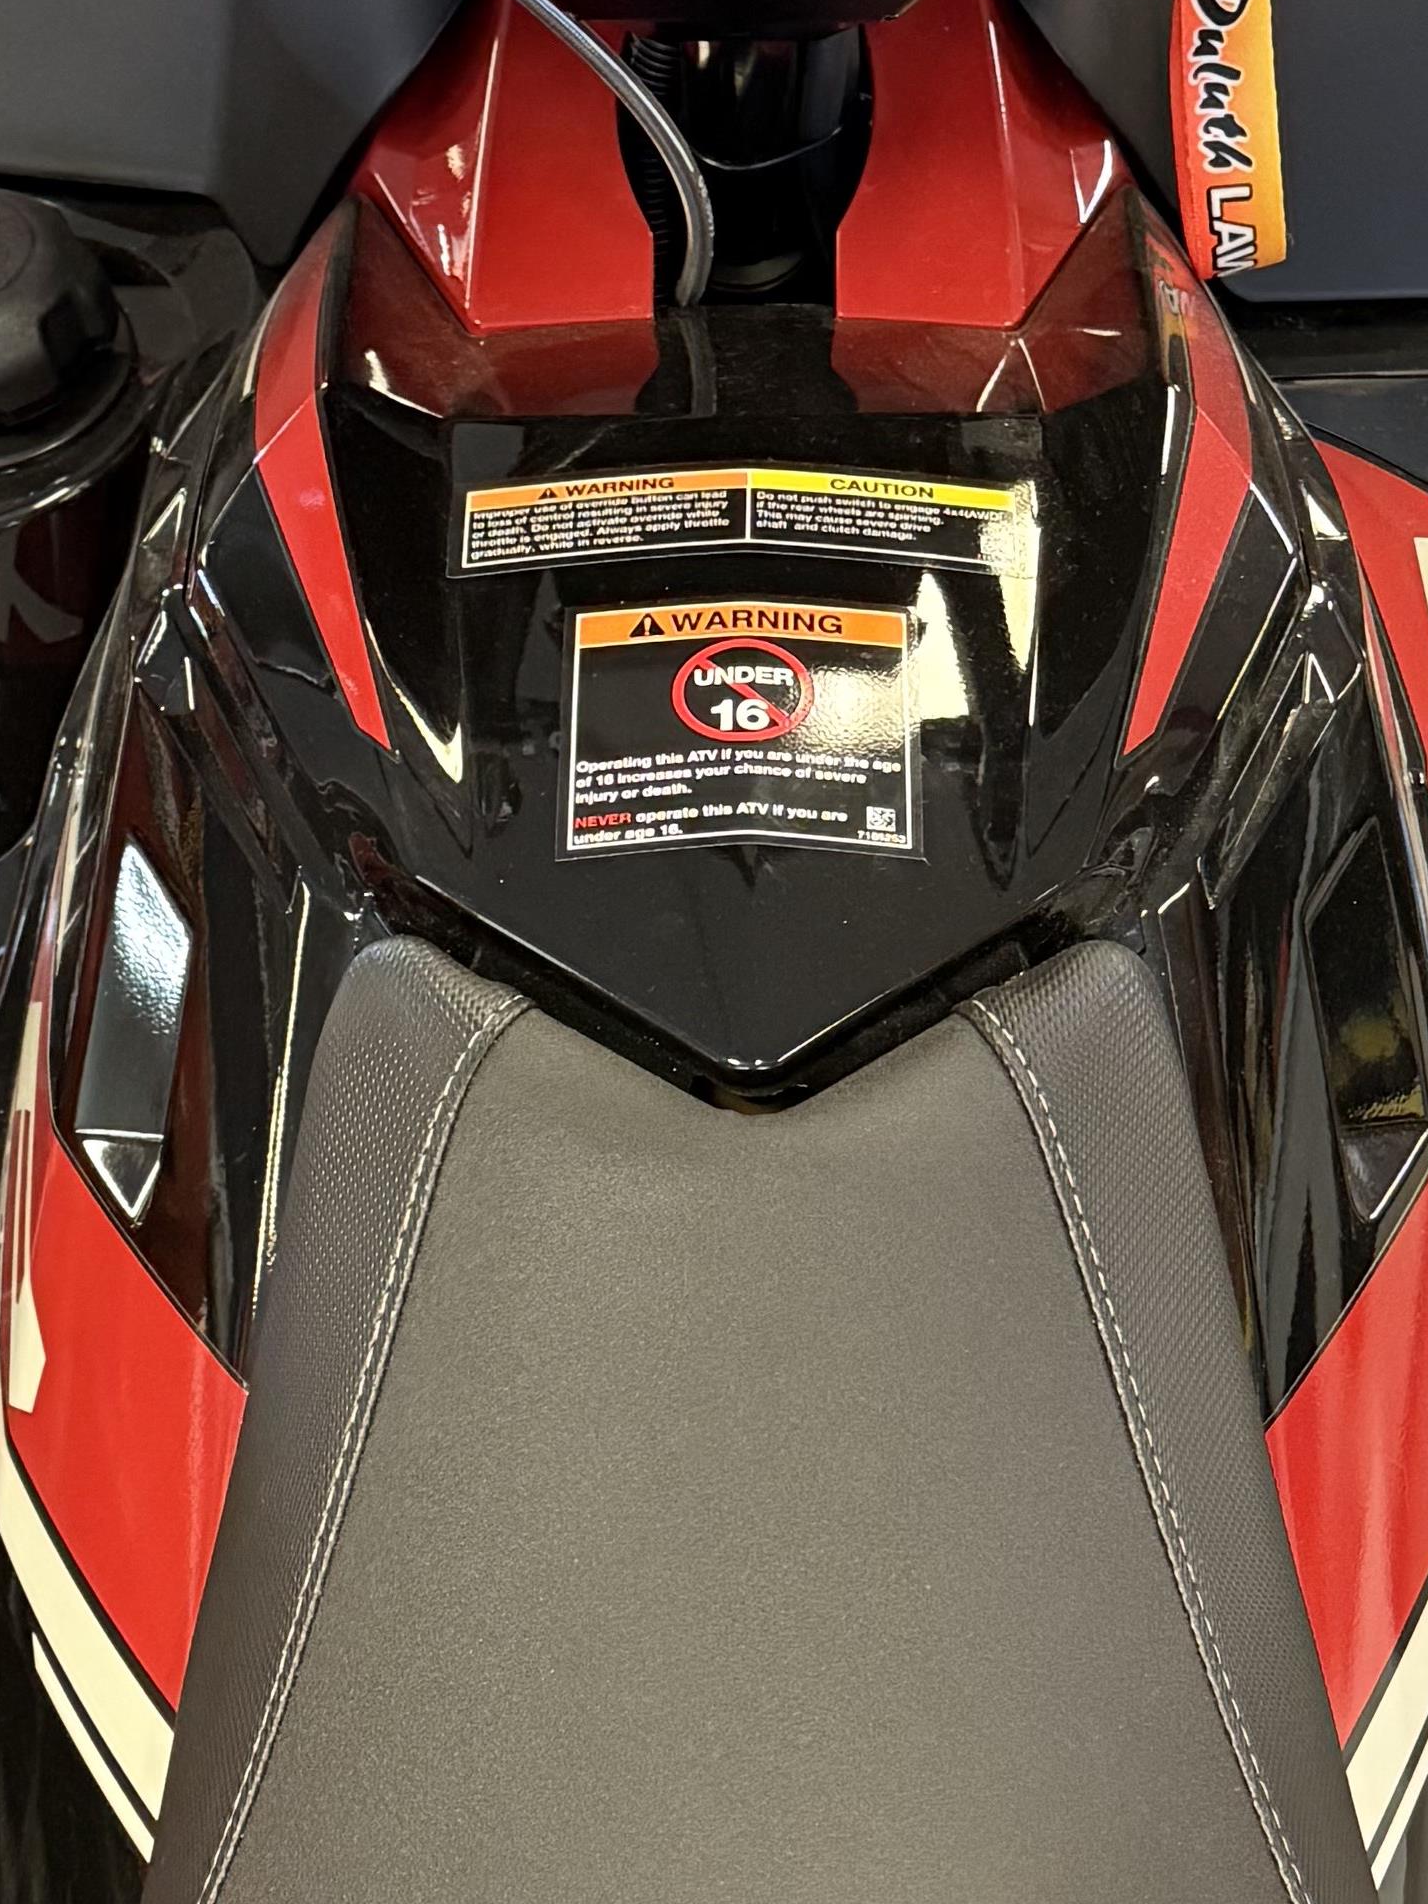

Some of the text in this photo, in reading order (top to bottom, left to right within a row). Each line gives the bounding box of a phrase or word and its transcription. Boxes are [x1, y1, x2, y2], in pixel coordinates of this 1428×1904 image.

[564, 477, 675, 497] WARNING
[830, 478, 935, 499] CAUTION
[756, 491, 775, 502] Do
[777, 492, 798, 503] not
[801, 494, 832, 506] push
[835, 497, 876, 509] switch
[878, 500, 891, 510] to
[894, 503, 940, 516] engage
[766, 501, 788, 512] the
[790, 503, 816, 514] rear
[818, 505, 861, 517] wheels
[864, 509, 885, 519] are
[533, 528, 594, 545] engaged.
[596, 524, 643, 537] Always
[645, 520, 681, 533] apply
[756, 509, 931, 533] This may cause severe drive
[756, 518, 917, 542] shaft and clutch damage.
[539, 540, 574, 551] while
[671, 609, 843, 635] WARNING
[693, 666, 794, 686] UNDER
[710, 698, 770, 732] 16
[576, 748, 901, 774] Operating this ATV if you are under the age
[575, 763, 867, 789] of 16 increases your chance of severe
[575, 782, 693, 806] injury or death.
[575, 801, 848, 829] NEVER operate this ATV if you are
[574, 823, 684, 845] under age 16.
